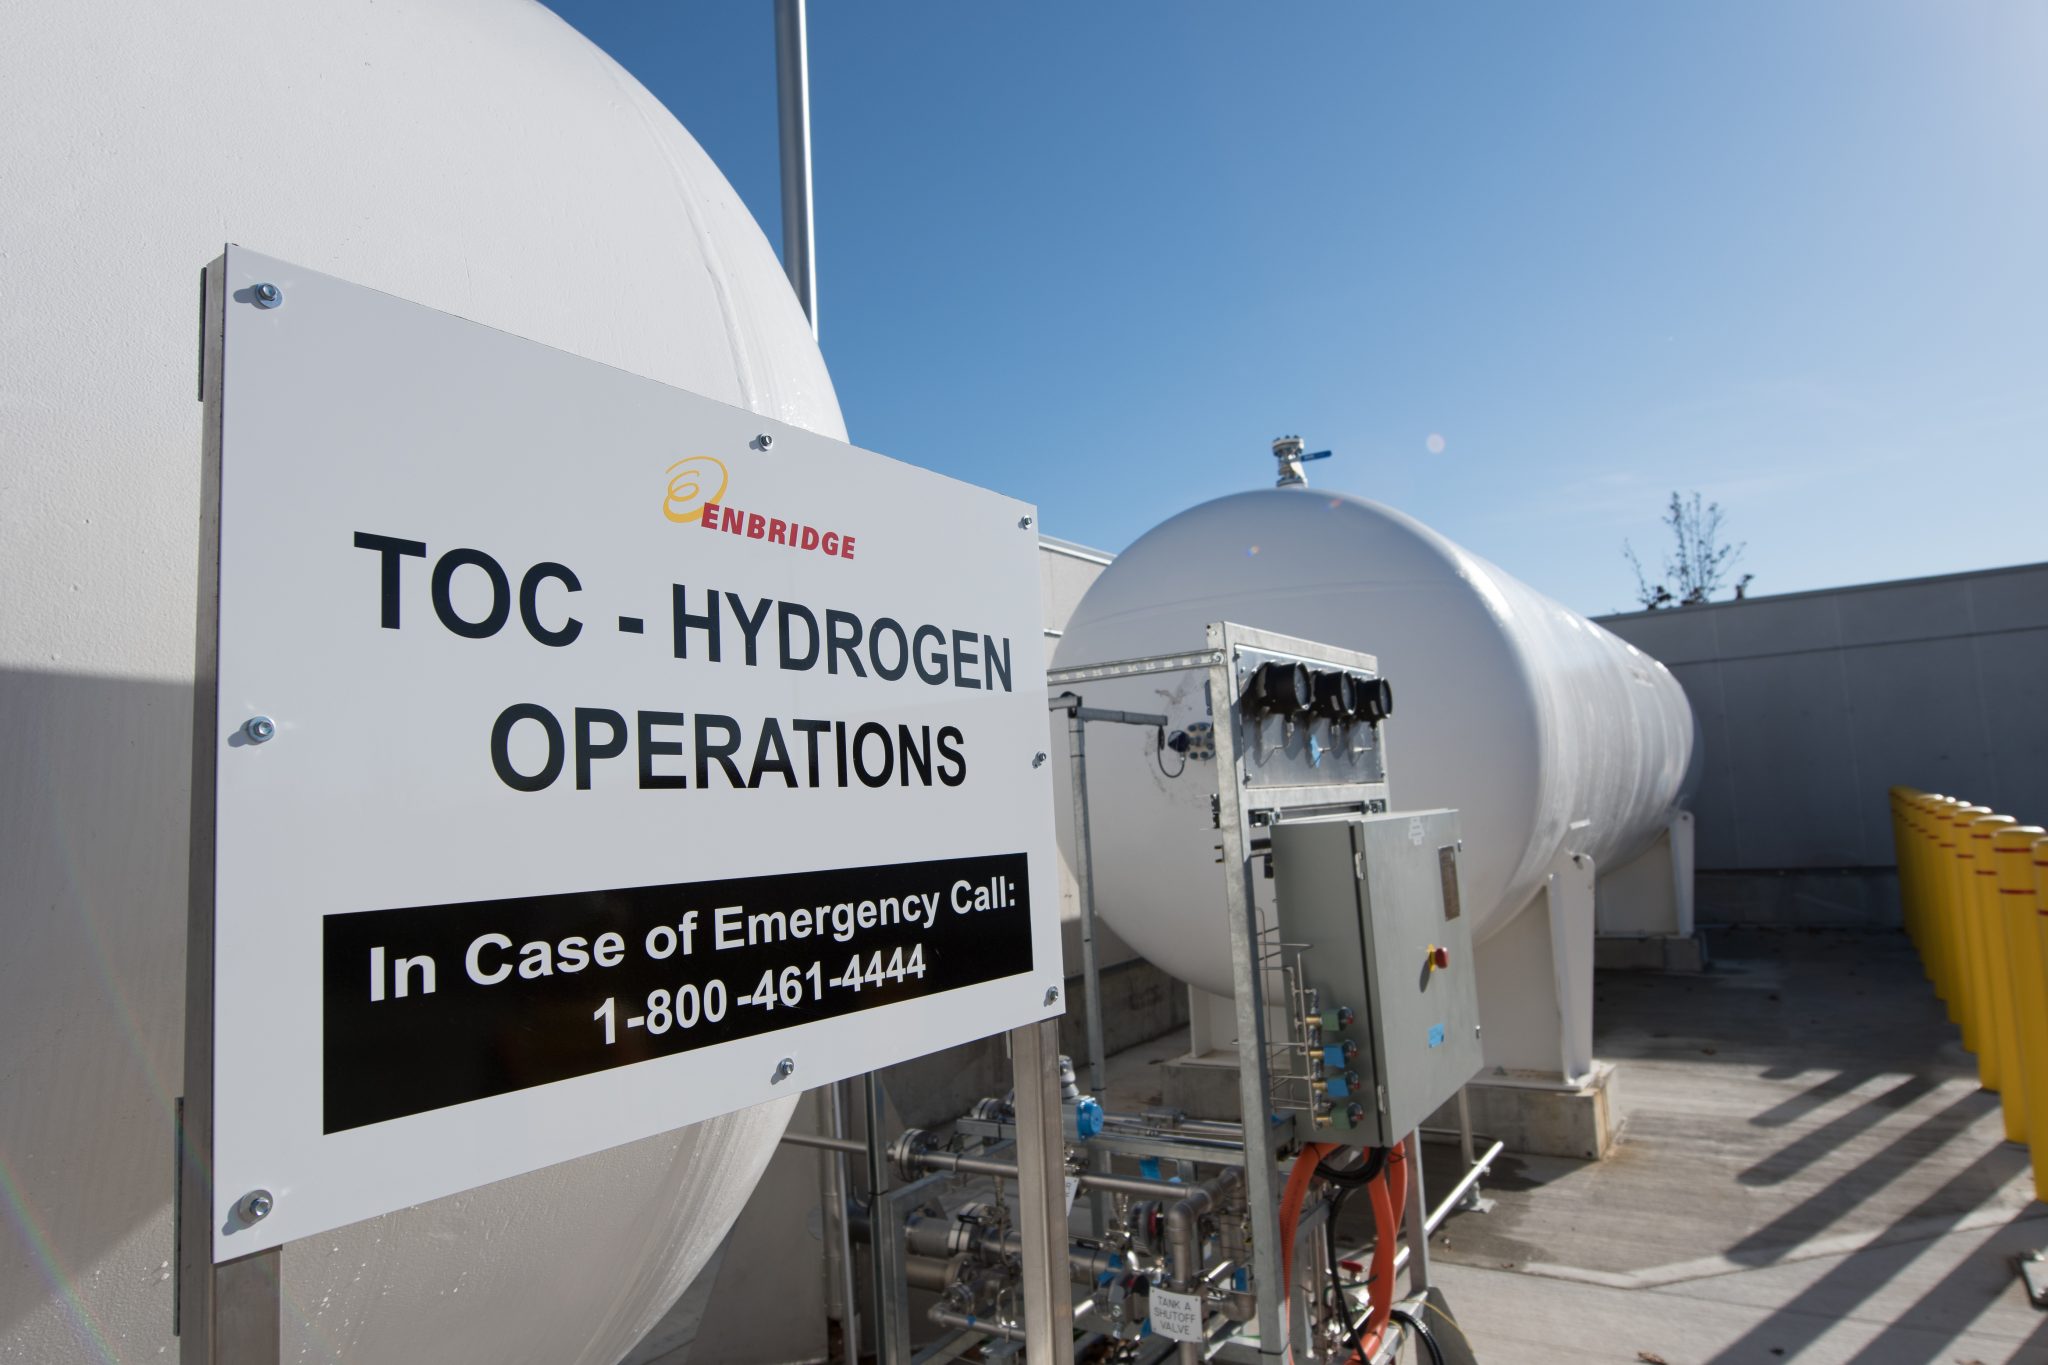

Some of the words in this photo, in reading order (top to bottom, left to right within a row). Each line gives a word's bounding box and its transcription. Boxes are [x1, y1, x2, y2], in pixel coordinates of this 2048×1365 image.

[701, 502, 856, 560] ENBRIDGE
[354, 530, 584, 648] TOC
[672, 583, 1012, 693] HYDROGEN
[490, 702, 967, 793] OPERATIONS
[370, 946, 436, 1002] In
[465, 933, 625, 986] Case
[645, 910, 699, 960] of
[714, 892, 940, 951] Emergency
[950, 875, 1017, 915] Call:
[1153, 1306, 1196, 1323] SHUTOFF
[1158, 1295, 1181, 1310] TANK
[1184, 1302, 1192, 1311] A
[1160, 1320, 1191, 1336] VALVE
